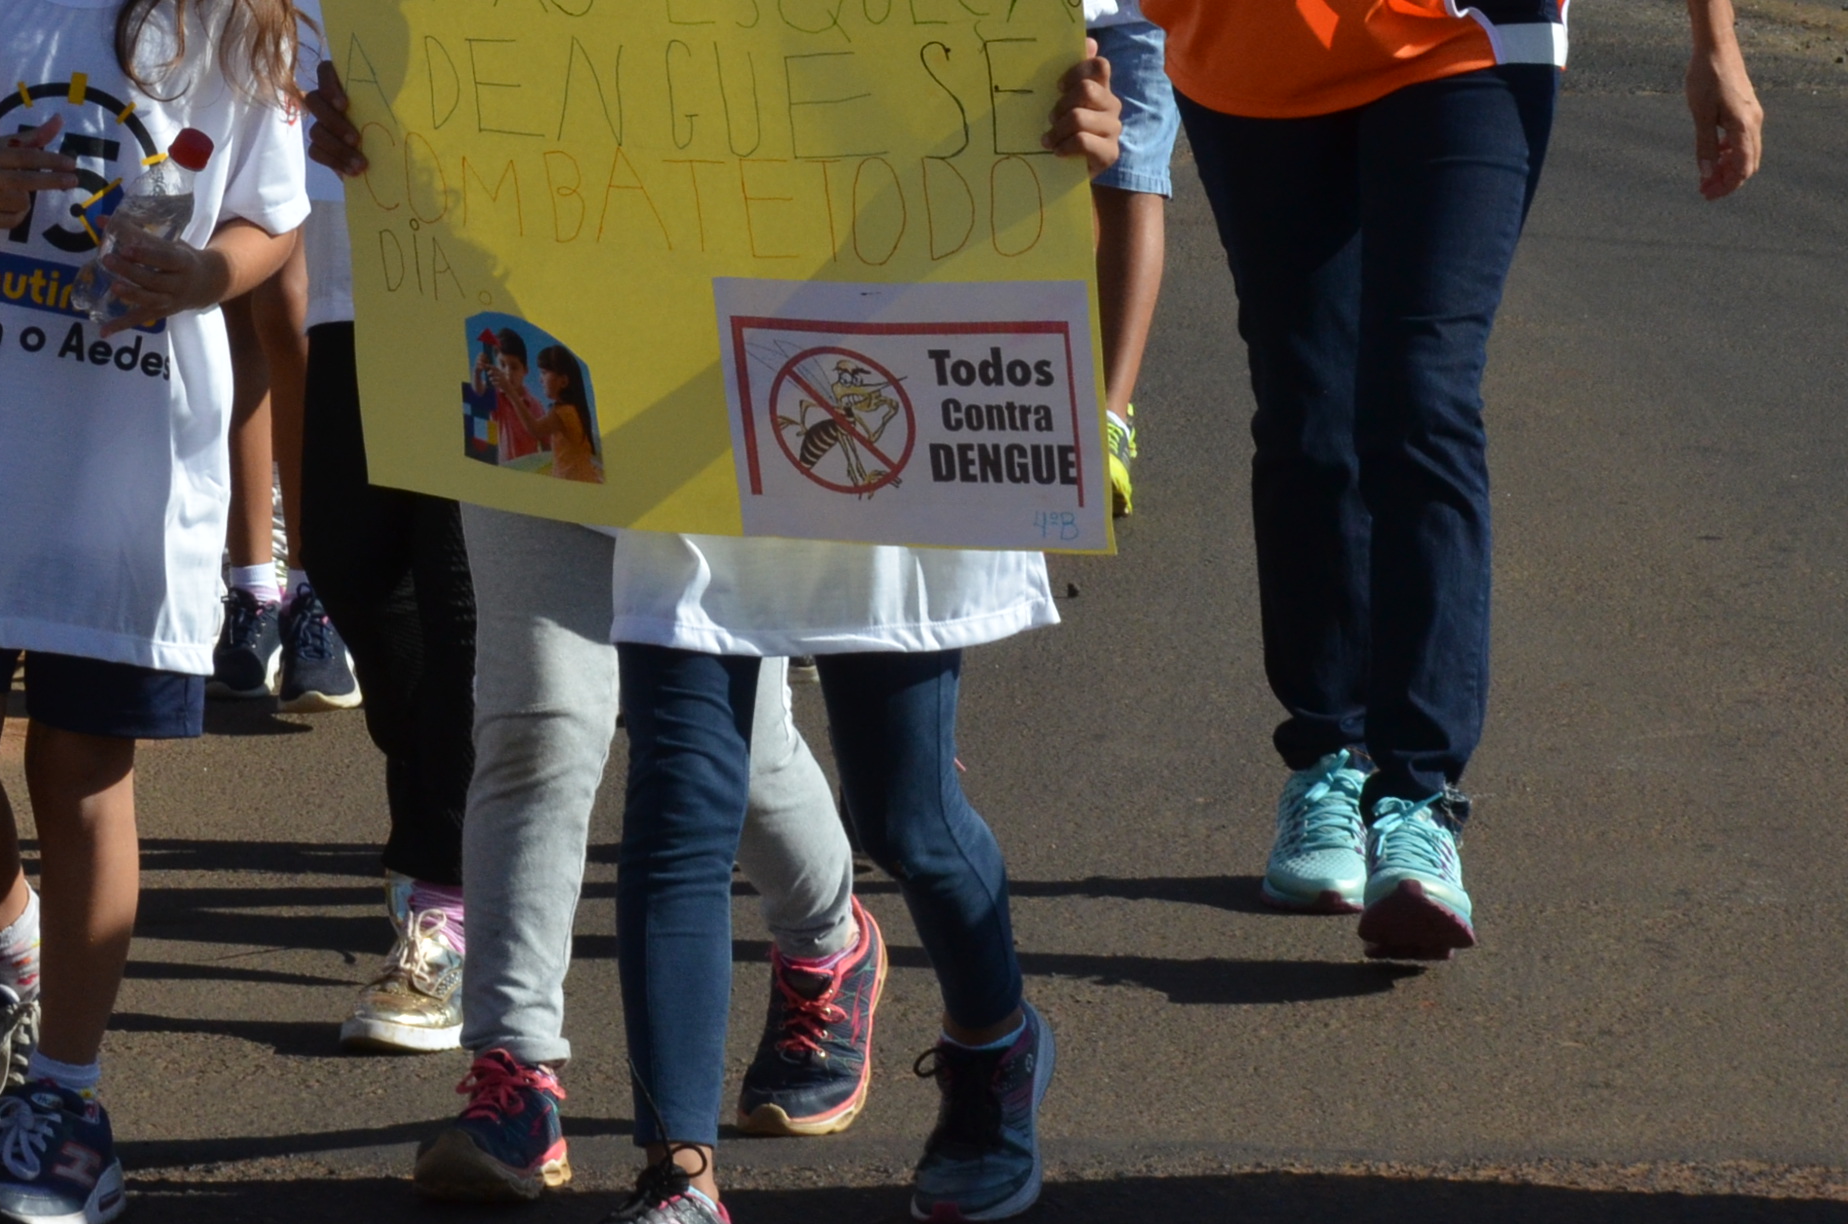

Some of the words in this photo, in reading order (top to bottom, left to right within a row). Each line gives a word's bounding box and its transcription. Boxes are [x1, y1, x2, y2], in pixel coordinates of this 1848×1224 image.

[342, 31, 399, 126] A
[423, 33, 890, 160] DENGUE
[919, 36, 1054, 162] SE
[19, 325, 47, 353] o
[927, 346, 1055, 388] Todos
[941, 397, 1054, 433] Contra
[928, 442, 1079, 486] DENGUE
